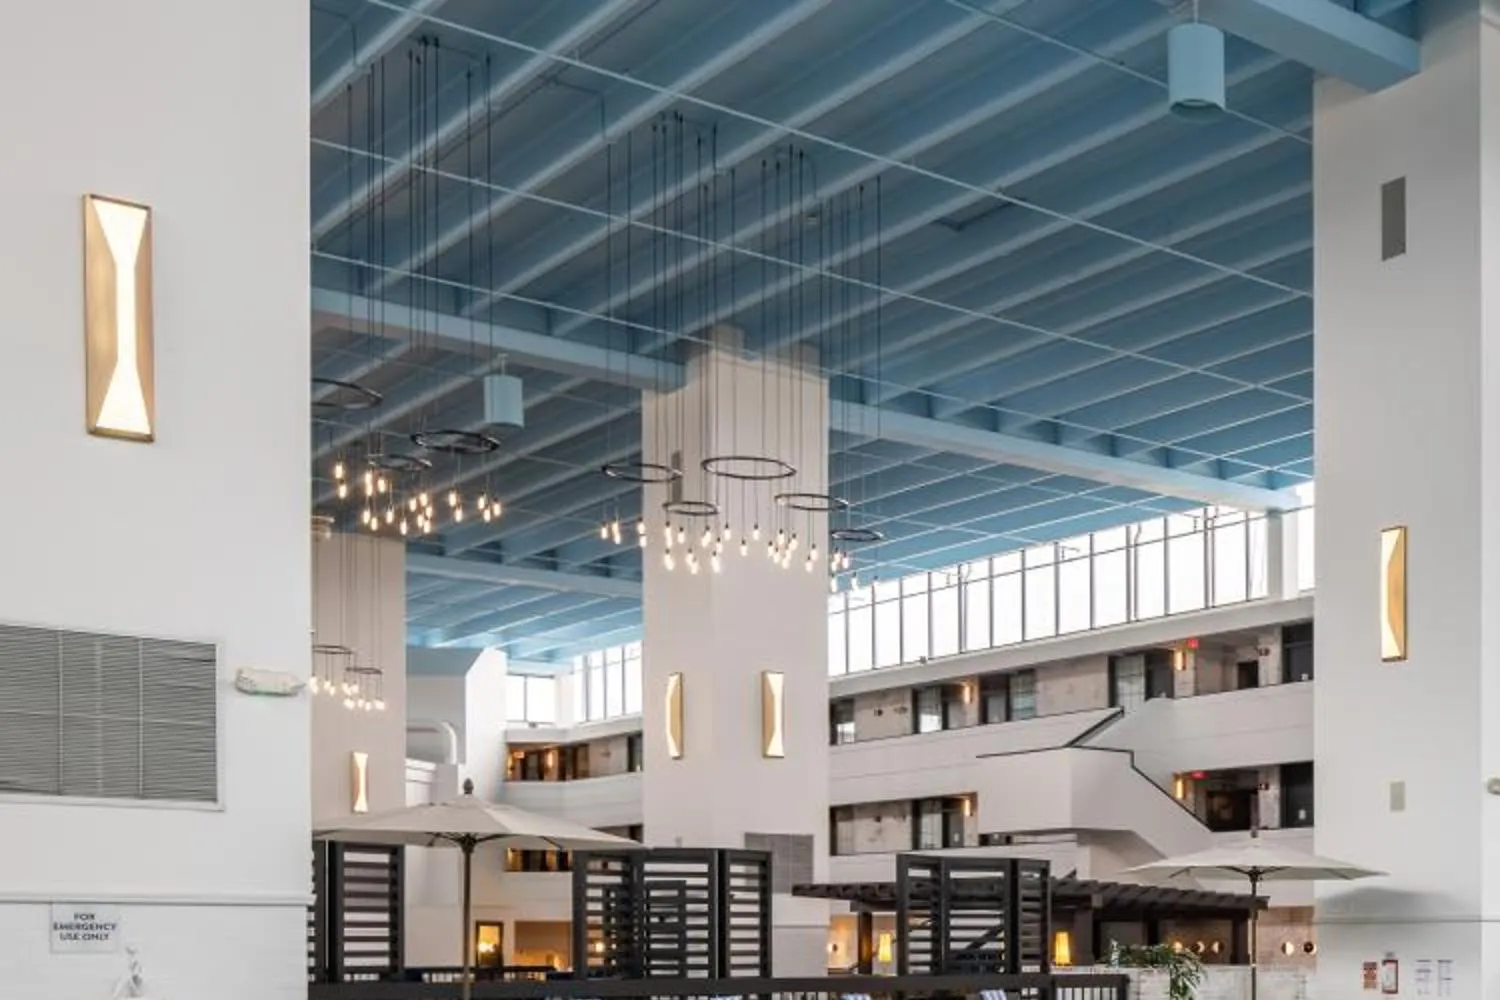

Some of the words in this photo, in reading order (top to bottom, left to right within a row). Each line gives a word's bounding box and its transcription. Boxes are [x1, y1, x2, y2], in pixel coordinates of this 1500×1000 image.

[73, 911, 96, 921] FOR
[53, 921, 117, 931] EMERGENCY
[59, 932, 80, 941] USE
[82, 932, 109, 941] ONLY
